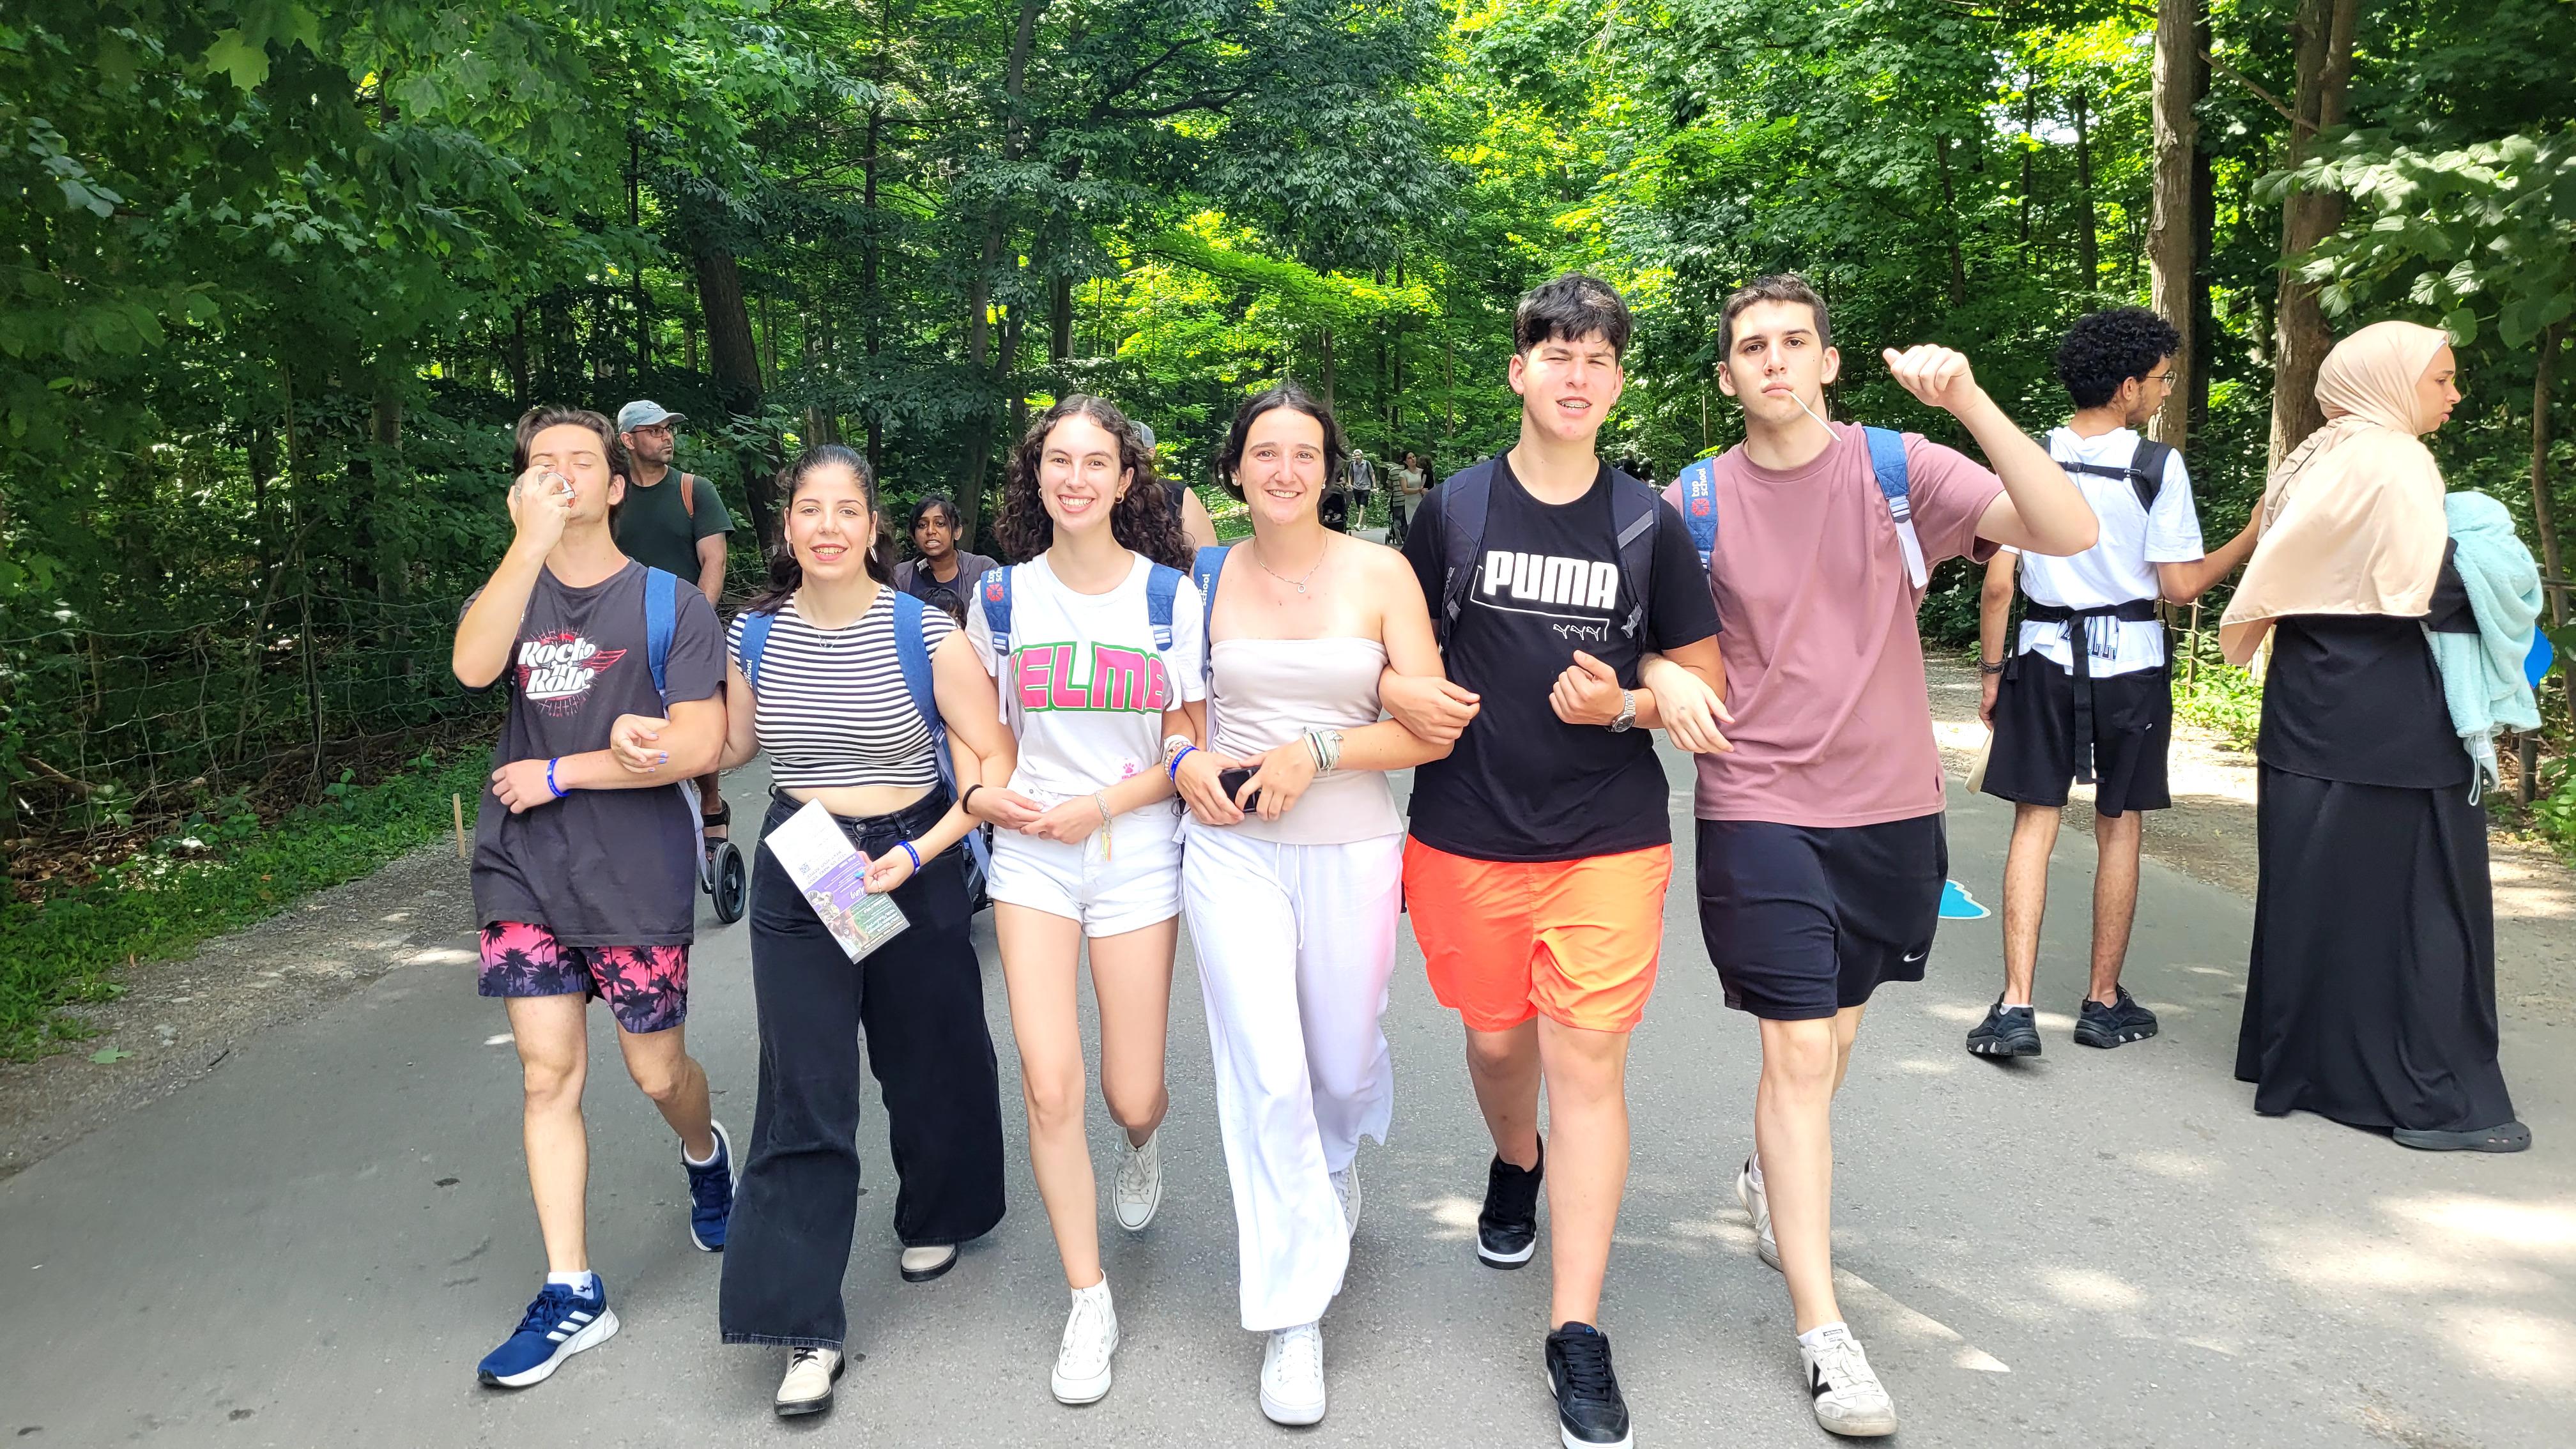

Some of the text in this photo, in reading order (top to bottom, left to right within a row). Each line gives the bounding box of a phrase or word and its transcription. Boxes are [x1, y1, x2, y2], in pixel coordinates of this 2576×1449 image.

[1691, 480, 1701, 497] top
[1695, 467, 1708, 496] school
[1483, 550, 1619, 610] PUMA
